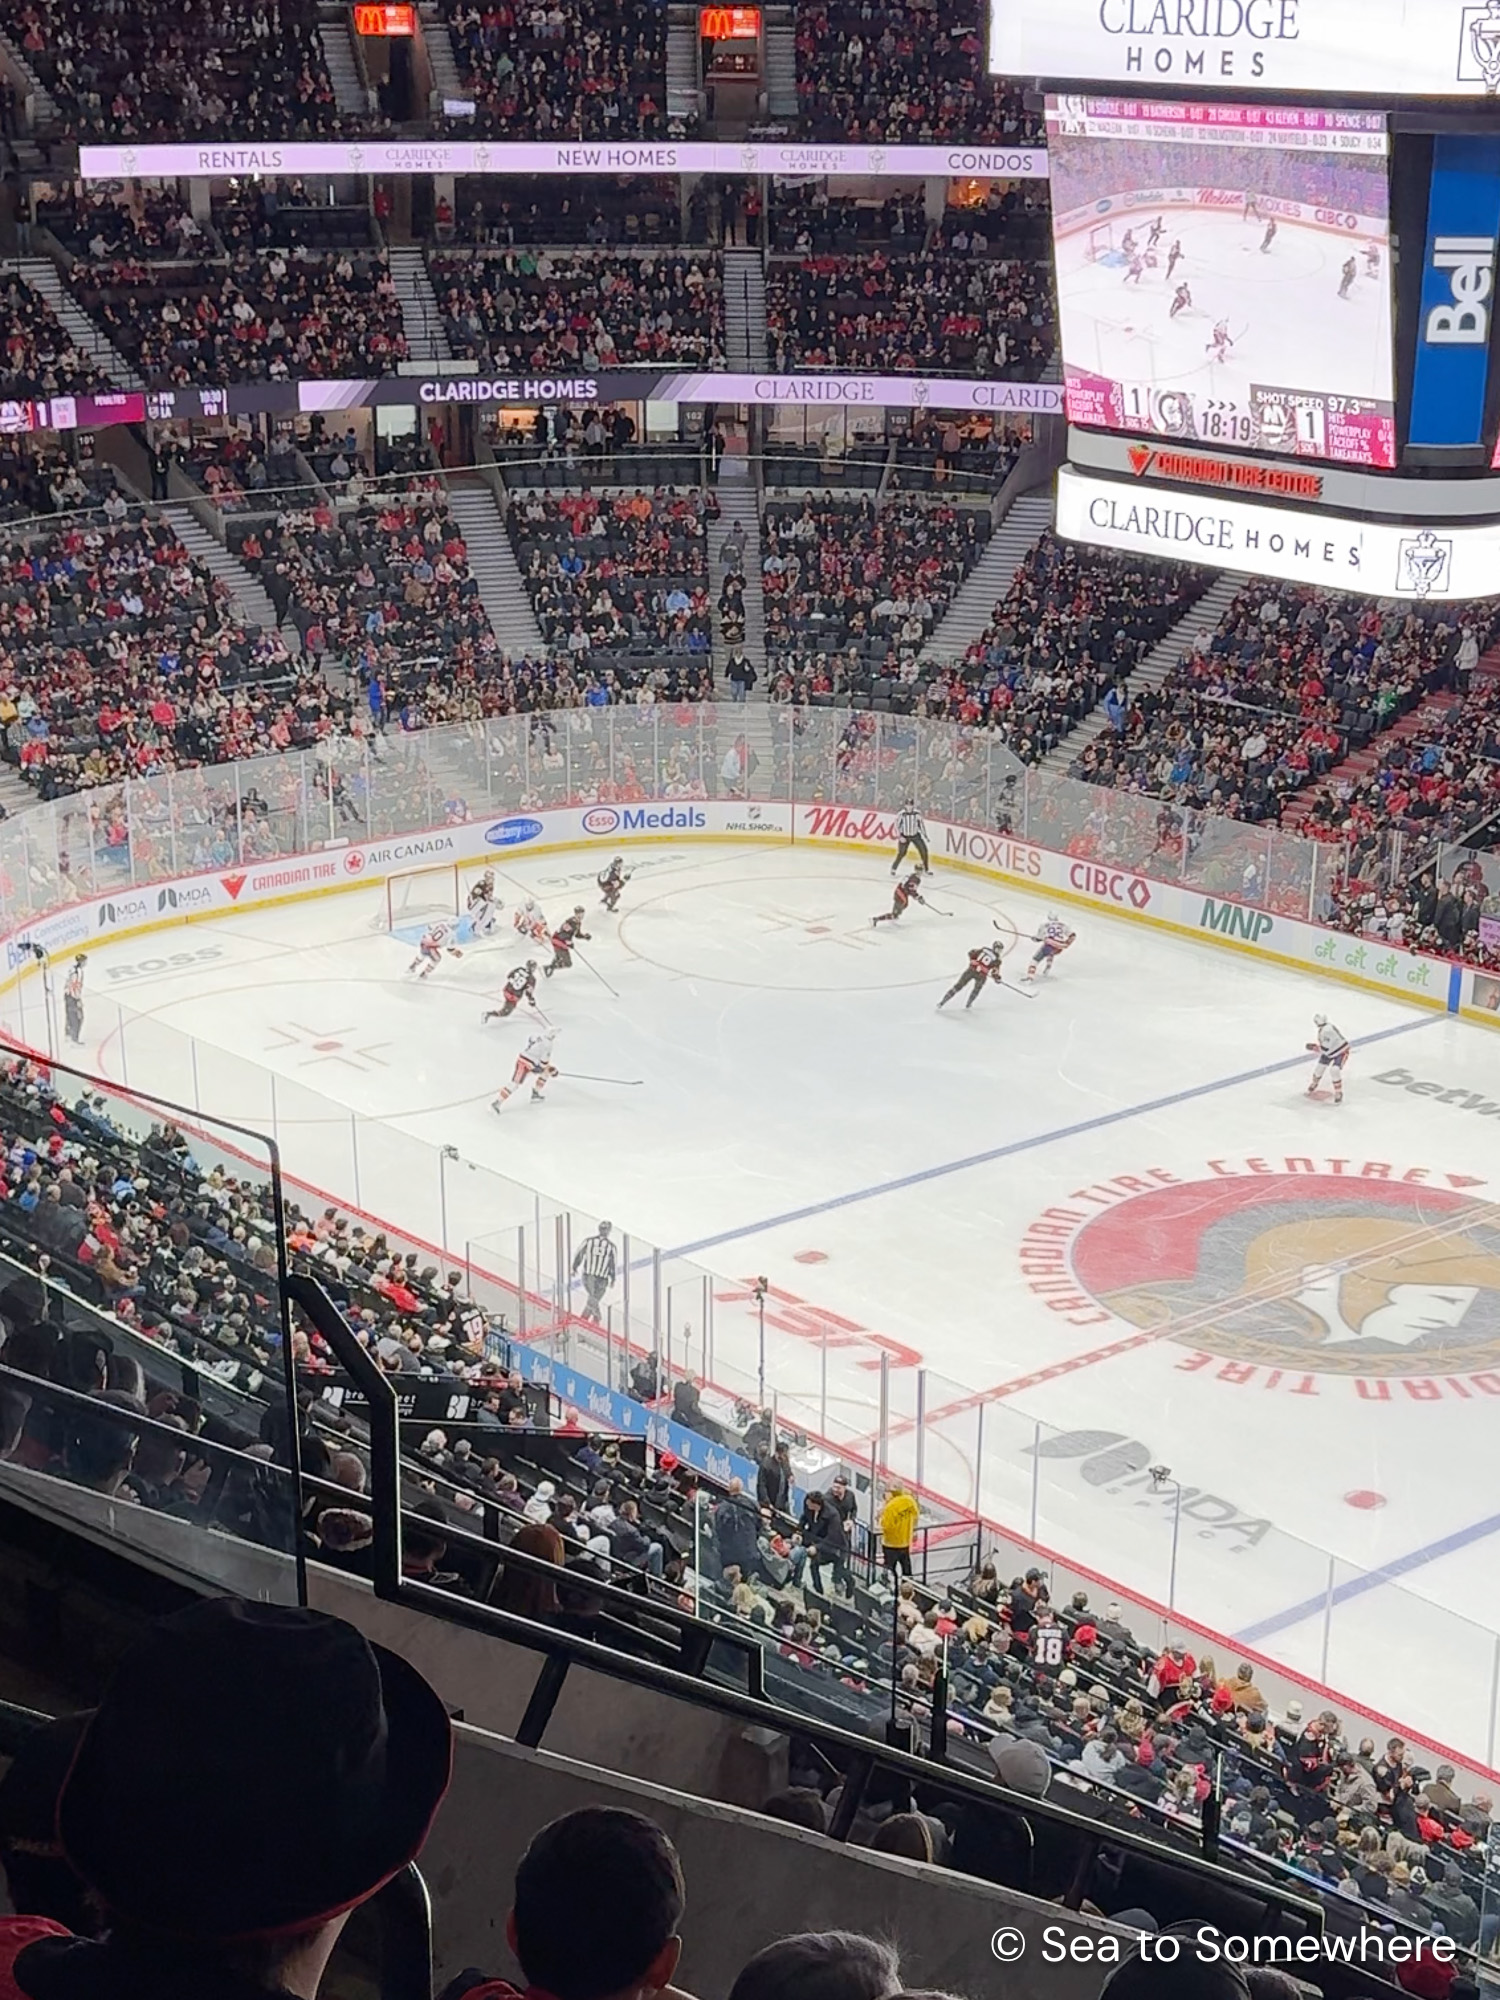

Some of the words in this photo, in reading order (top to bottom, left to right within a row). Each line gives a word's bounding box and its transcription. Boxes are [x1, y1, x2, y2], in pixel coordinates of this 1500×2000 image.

[1100, 0, 1300, 39] CLARIDGE
[1126, 46, 1265, 77] HOMES
[199, 151, 282, 169] RENTALS
[385, 149, 451, 161] CLARIDGE
[394, 161, 446, 169] HOMES
[557, 150, 600, 166] NEW
[607, 150, 677, 166] HOMES
[780, 149, 847, 162] CLARIDGE
[788, 162, 838, 170] HOMES
[948, 153, 1033, 171] CONDOS
[1314, 208, 1344, 226] CIBC
[1425, 236, 1494, 343] Bell
[419, 381, 520, 401] CLARIDGE
[523, 379, 598, 399] HOMES
[754, 381, 875, 401] CLARIDGE
[1132, 388, 1140, 414] 1
[1256, 391, 1287, 405] SHOT
[1288, 394, 1324, 410] SPEED
[1327, 396, 1361, 415] 97.3
[1202, 410, 1250, 441] 18:19
[1305, 411, 1315, 439] 1
[1089, 498, 1234, 549] CLARIDGE
[1245, 528, 1361, 567] HOMES
[587, 813, 616, 828] Esso
[622, 806, 706, 830] Medals
[368, 849, 392, 865] AIR
[394, 837, 454, 860] CANADA
[945, 828, 1042, 877] MOXIES
[252, 868, 311, 891] CANADIAN
[313, 862, 336, 878] TIRE
[1069, 863, 1124, 902] CIBC
[179, 886, 212, 903] MDA
[117, 900, 147, 917] MDA
[1200, 898, 1273, 943] MNP
[105, 944, 223, 979] ROSS
[1018, 1207, 1113, 1326] CANADIAN
[1068, 1167, 1184, 1205] TIRE
[1208, 1156, 1431, 1186] CENTRE
[463, 1315, 483, 1342] 19
[1174, 1352, 1320, 1397] TIRE
[1122, 1473, 1273, 1547] MDA
[1035, 1637, 1062, 1666] 18
